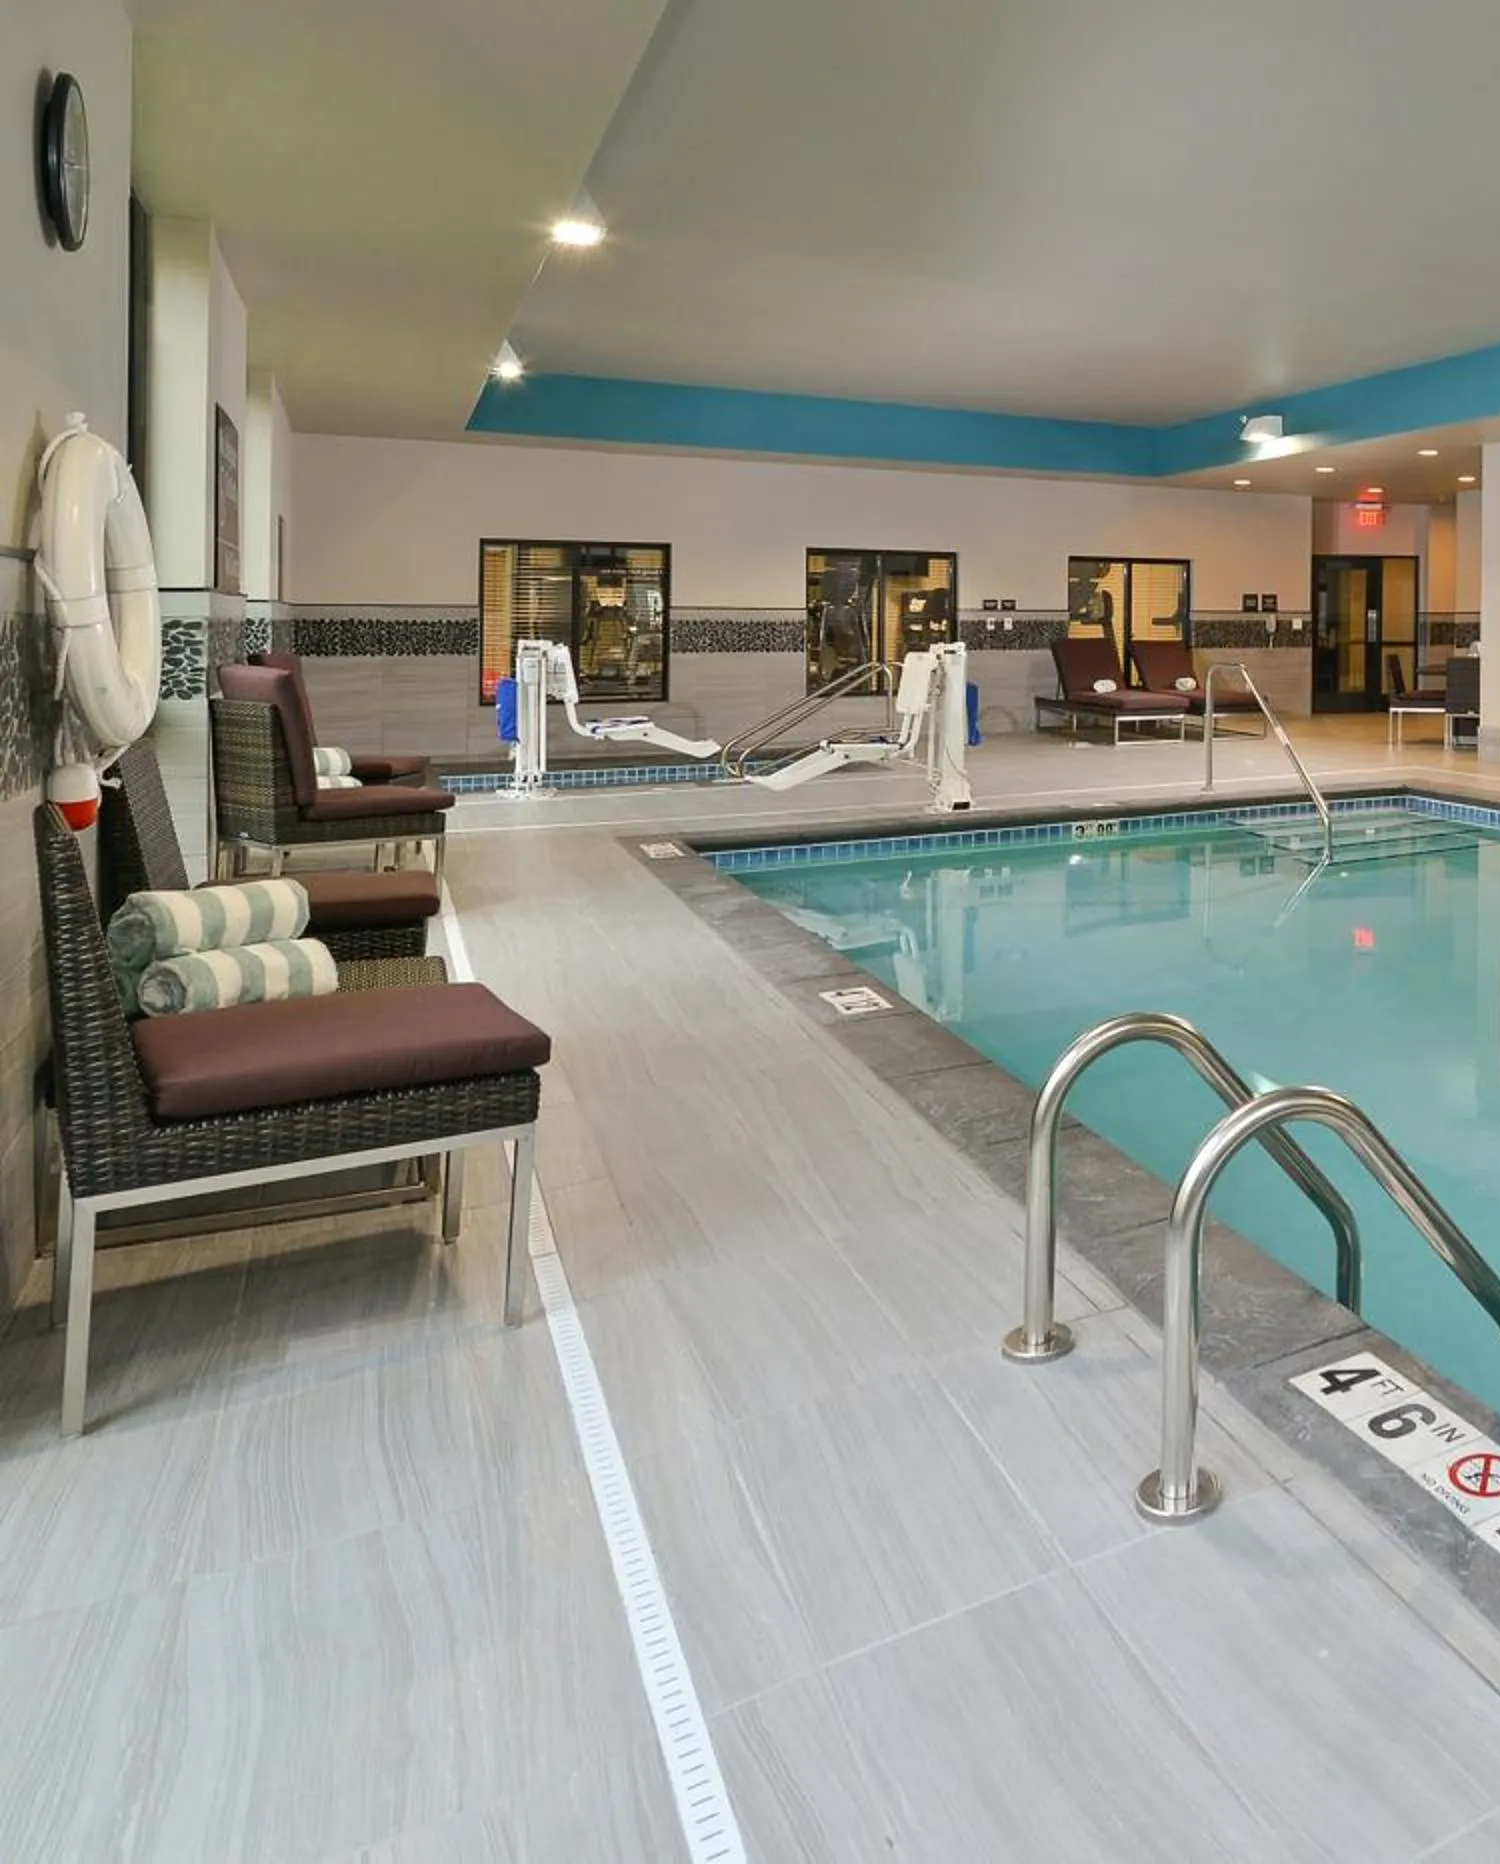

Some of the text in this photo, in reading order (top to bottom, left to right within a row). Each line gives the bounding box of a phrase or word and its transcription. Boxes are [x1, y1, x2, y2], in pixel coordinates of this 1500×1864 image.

[1319, 1367, 1383, 1398] 4
[1370, 1379, 1406, 1398] FT
[1367, 1402, 1437, 1440] 6
[1430, 1422, 1468, 1445] IN
